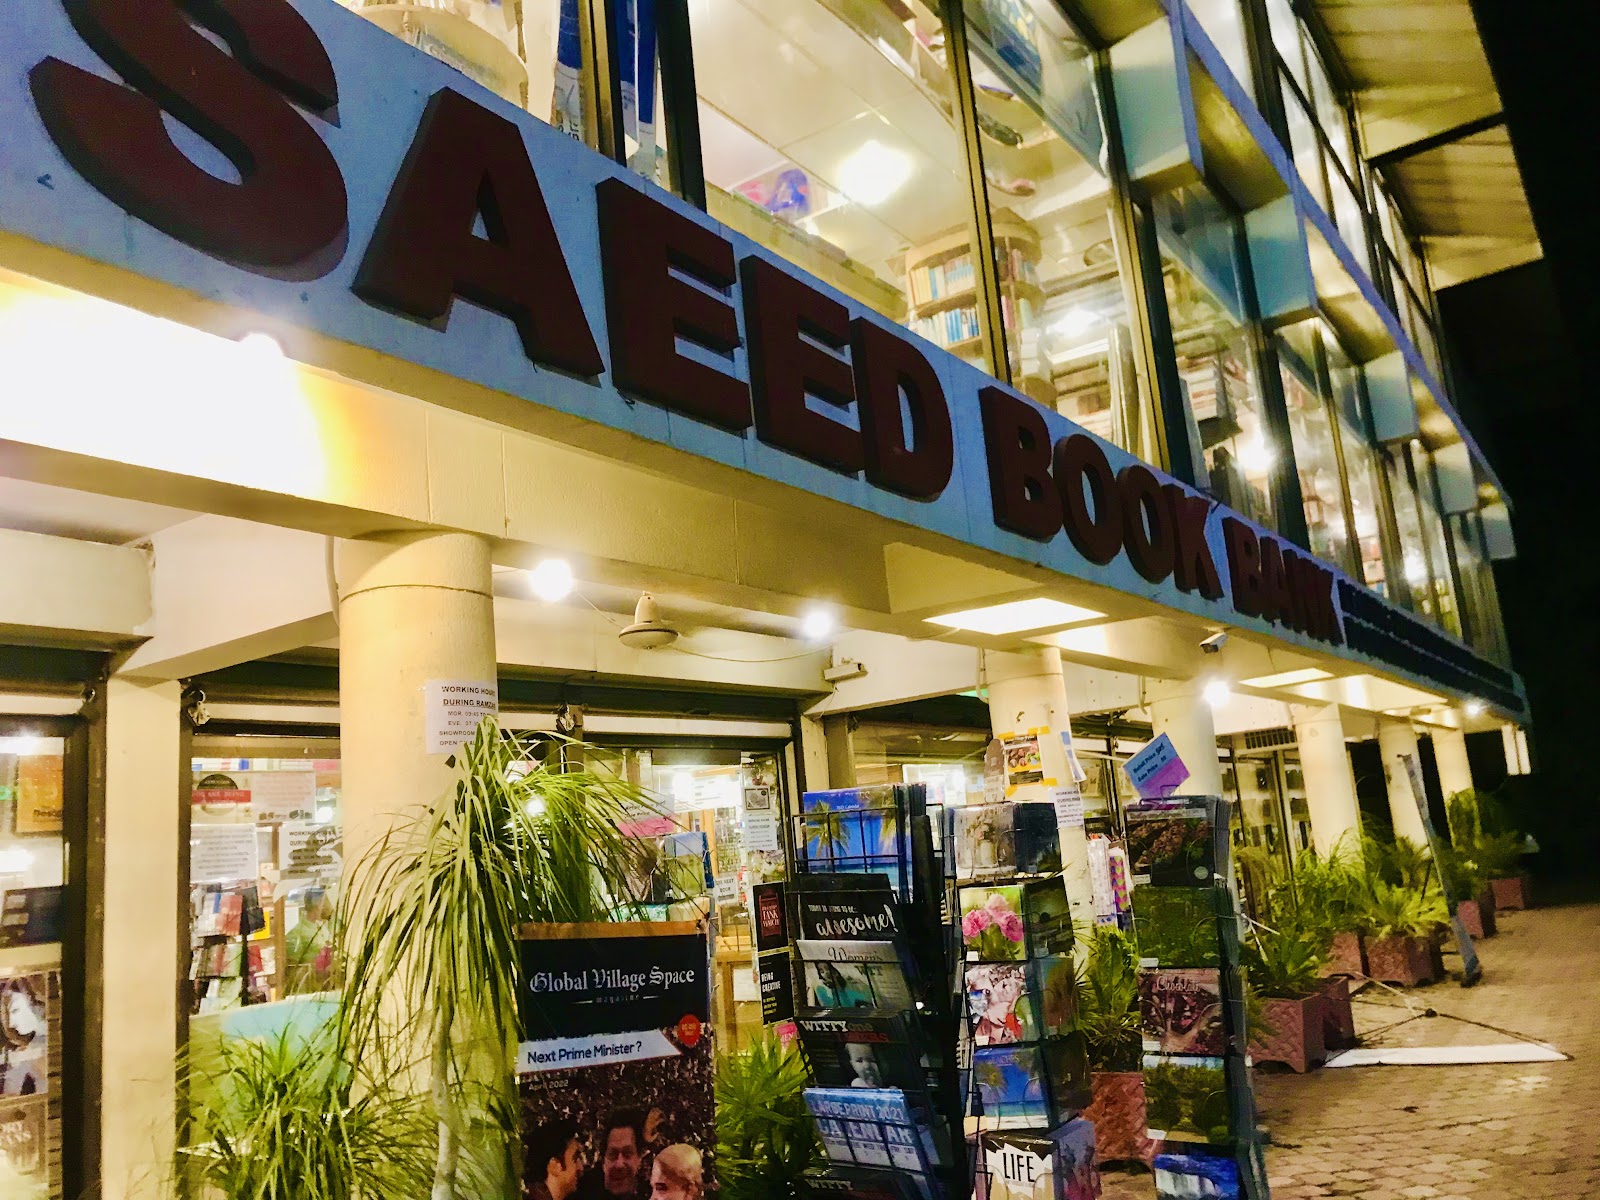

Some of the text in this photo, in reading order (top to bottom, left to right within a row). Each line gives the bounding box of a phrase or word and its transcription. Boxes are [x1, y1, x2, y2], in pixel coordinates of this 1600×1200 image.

[29, 0, 954, 502] SAEED
[978, 385, 1225, 601] BOOK
[1221, 517, 1345, 647] BANK
[441, 685, 480, 694] WORKING
[442, 698, 475, 706] DURING
[529, 965, 695, 993] Global Village Space
[799, 1020, 849, 1033] WITTY
[527, 1050, 556, 1065] Next
[558, 1047, 592, 1062] Prime
[549, 1079, 569, 1090] 2022
[1002, 1152, 1036, 1183] LIFE
[804, 1179, 854, 1191] WITTY
